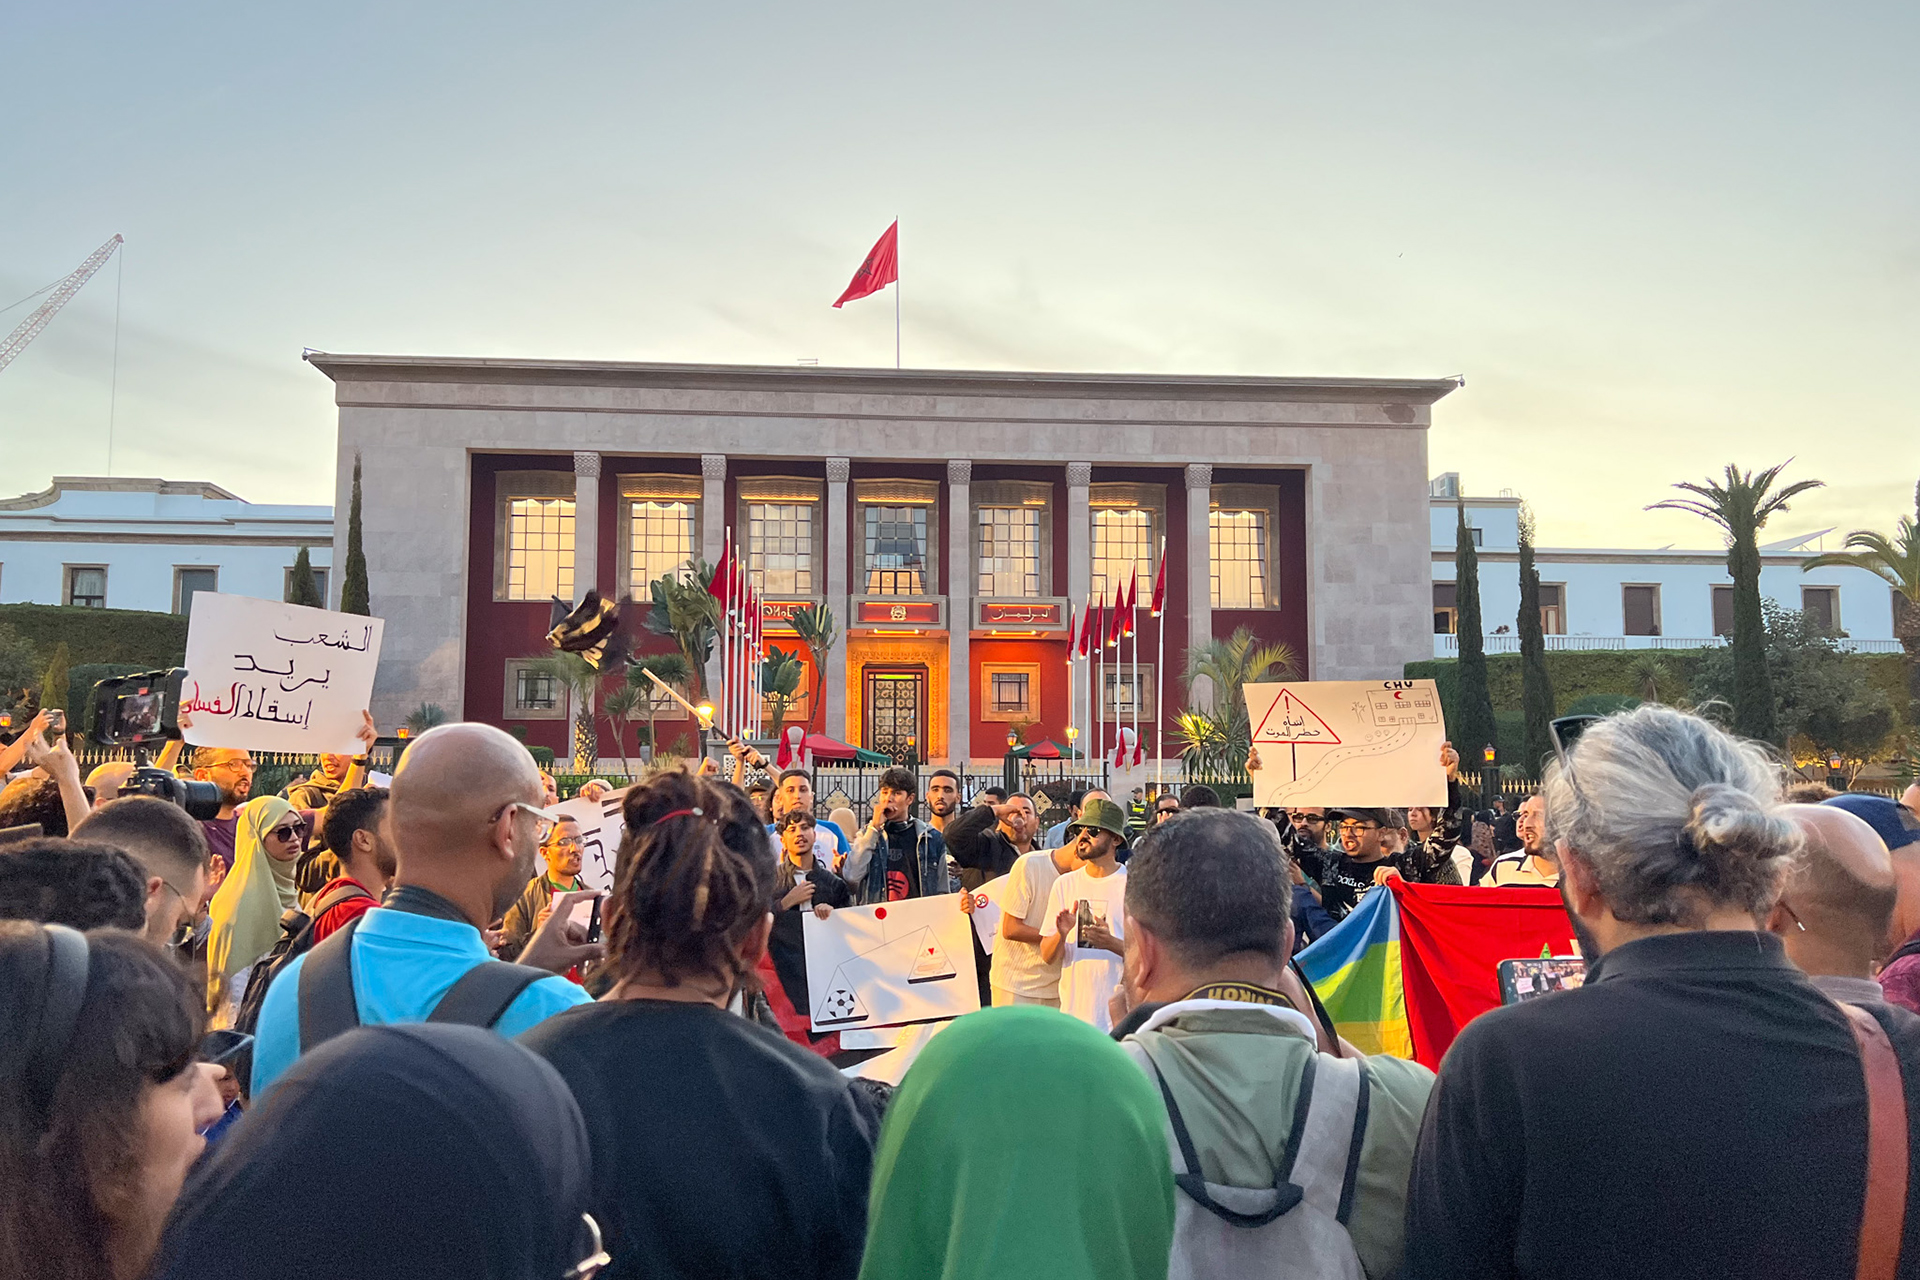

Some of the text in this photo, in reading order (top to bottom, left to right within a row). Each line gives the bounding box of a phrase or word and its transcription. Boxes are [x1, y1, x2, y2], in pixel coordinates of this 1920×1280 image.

[273, 624, 372, 653] الشعب
[234, 654, 330, 692] يريد
[1383, 681, 1413, 689] CHU
[181, 681, 313, 730] إسقاط الفساد
[1266, 726, 1291, 739] الموت
